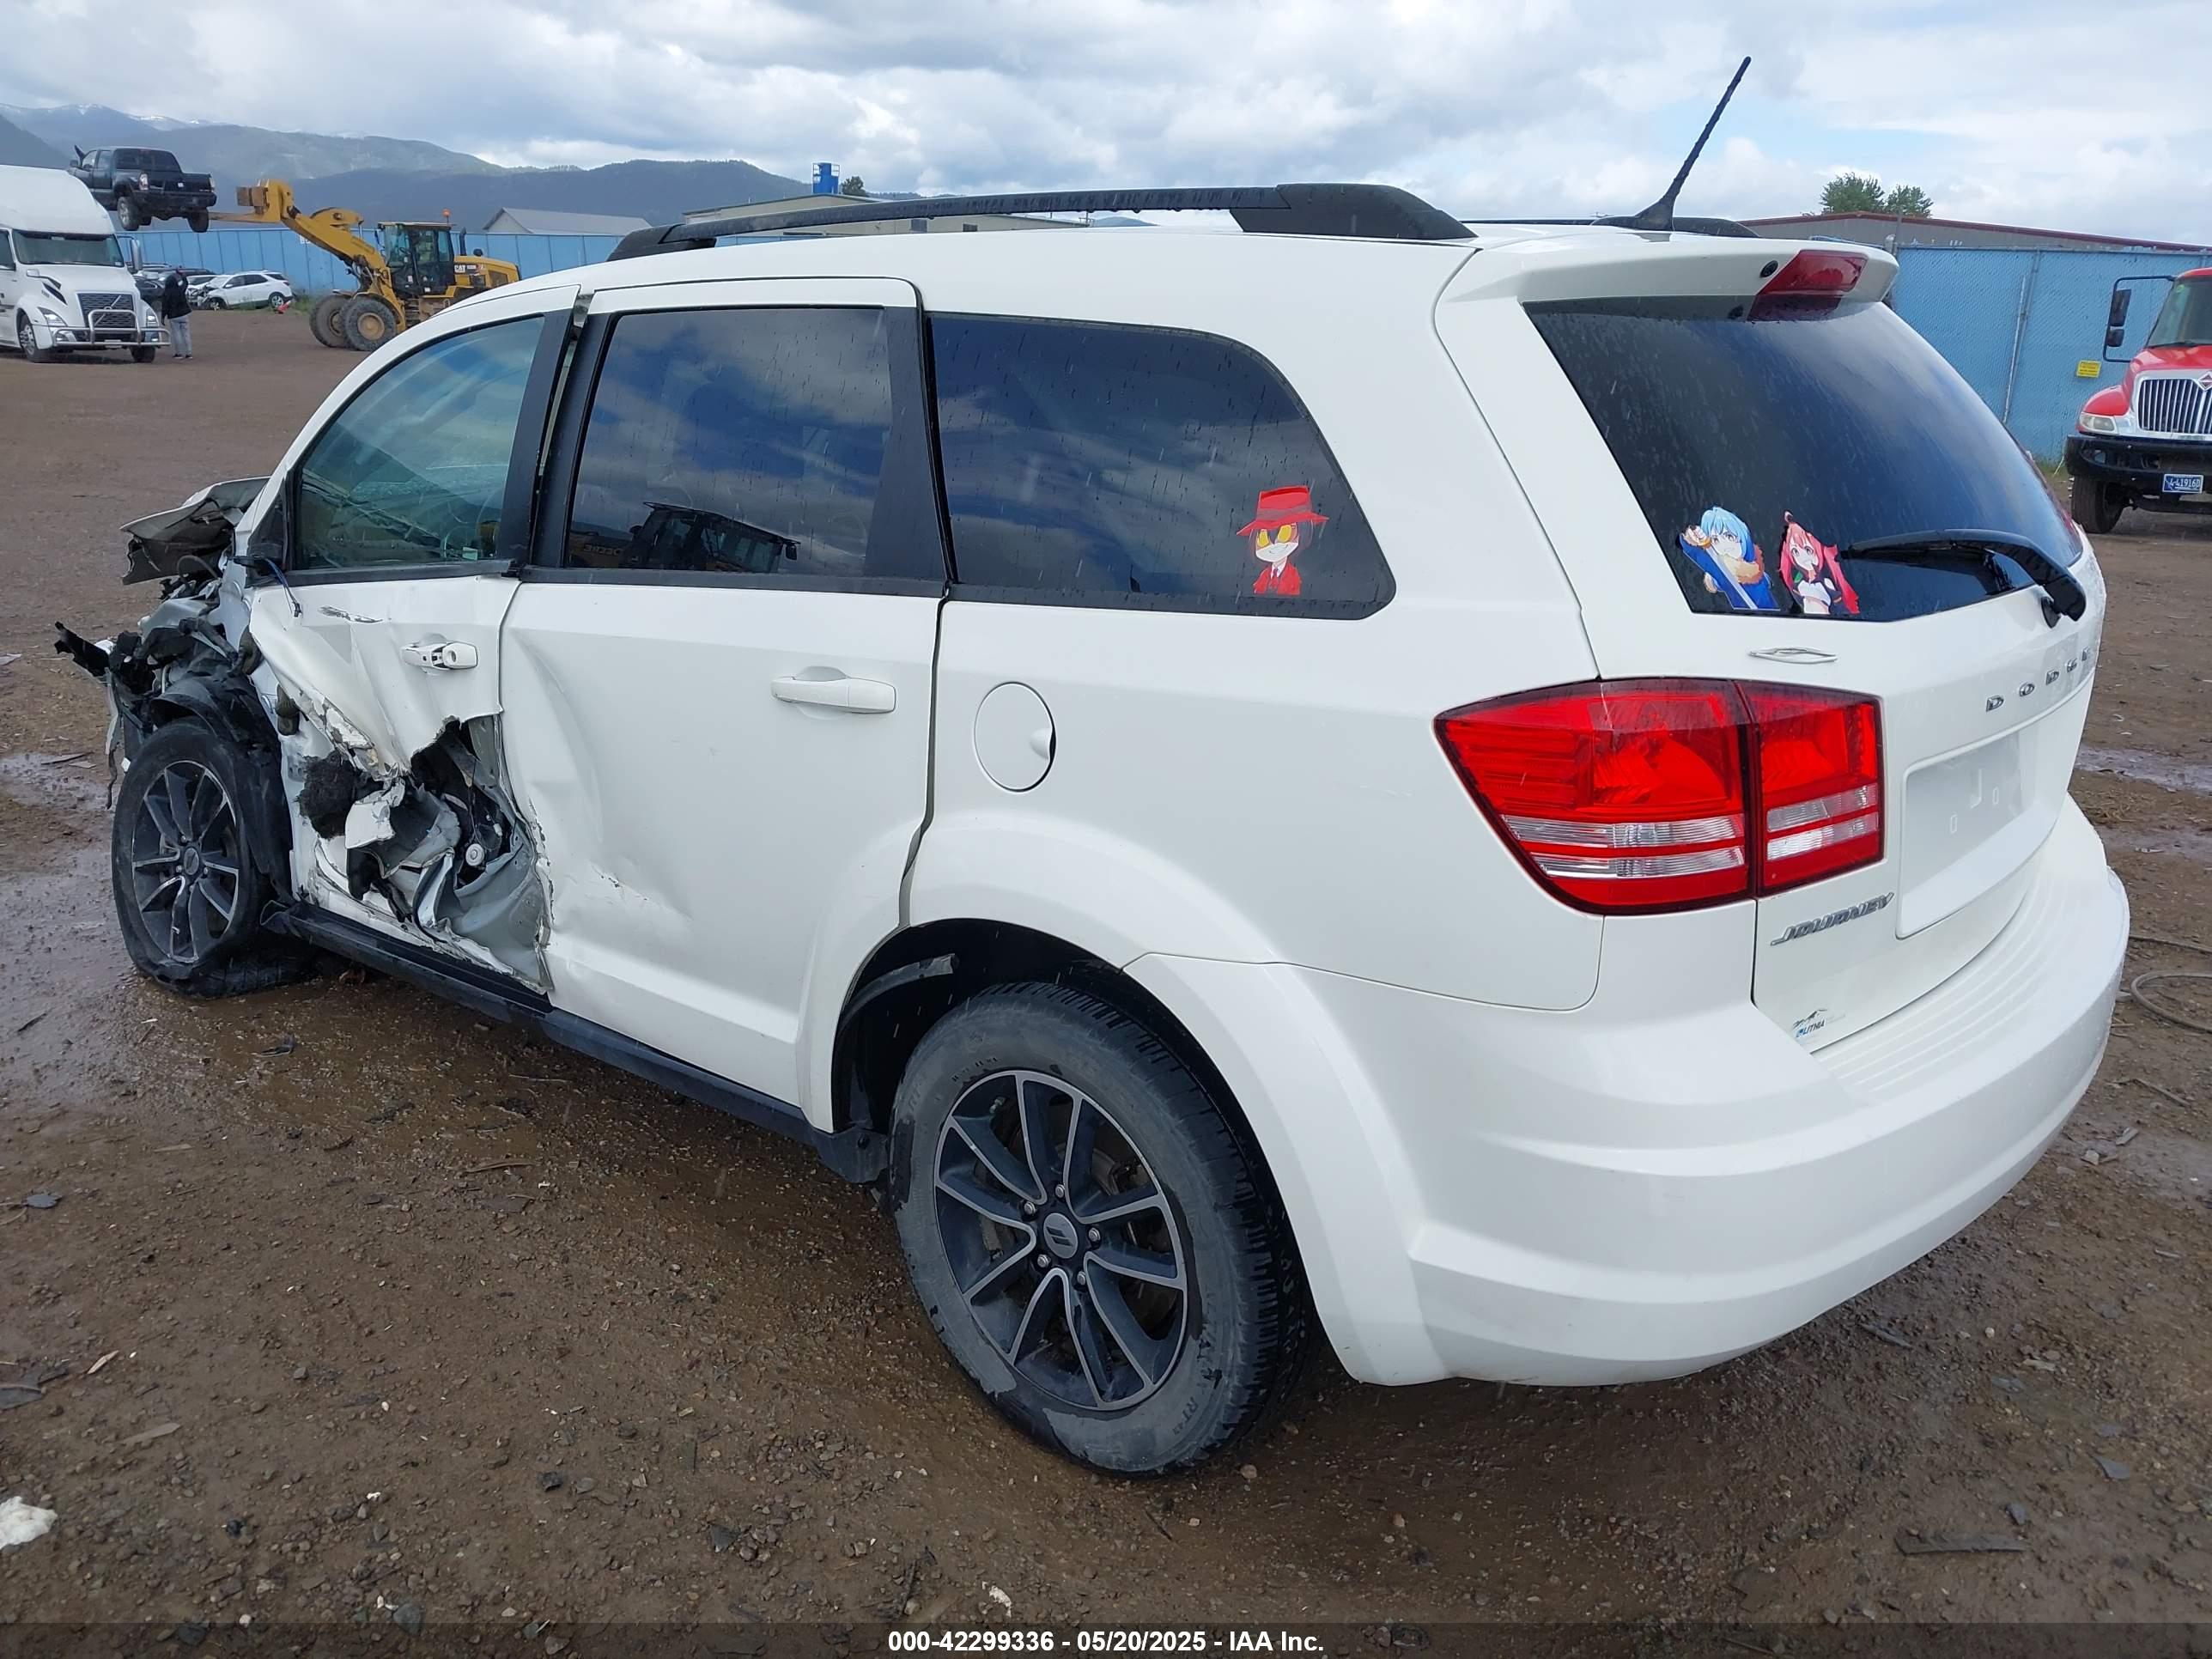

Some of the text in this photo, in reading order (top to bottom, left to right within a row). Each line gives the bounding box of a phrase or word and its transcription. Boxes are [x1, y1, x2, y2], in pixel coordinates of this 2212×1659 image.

[454, 264, 466, 273] CAT
[1985, 646, 2091, 713] DODGE
[1770, 891, 1894, 946] JOURNEY
